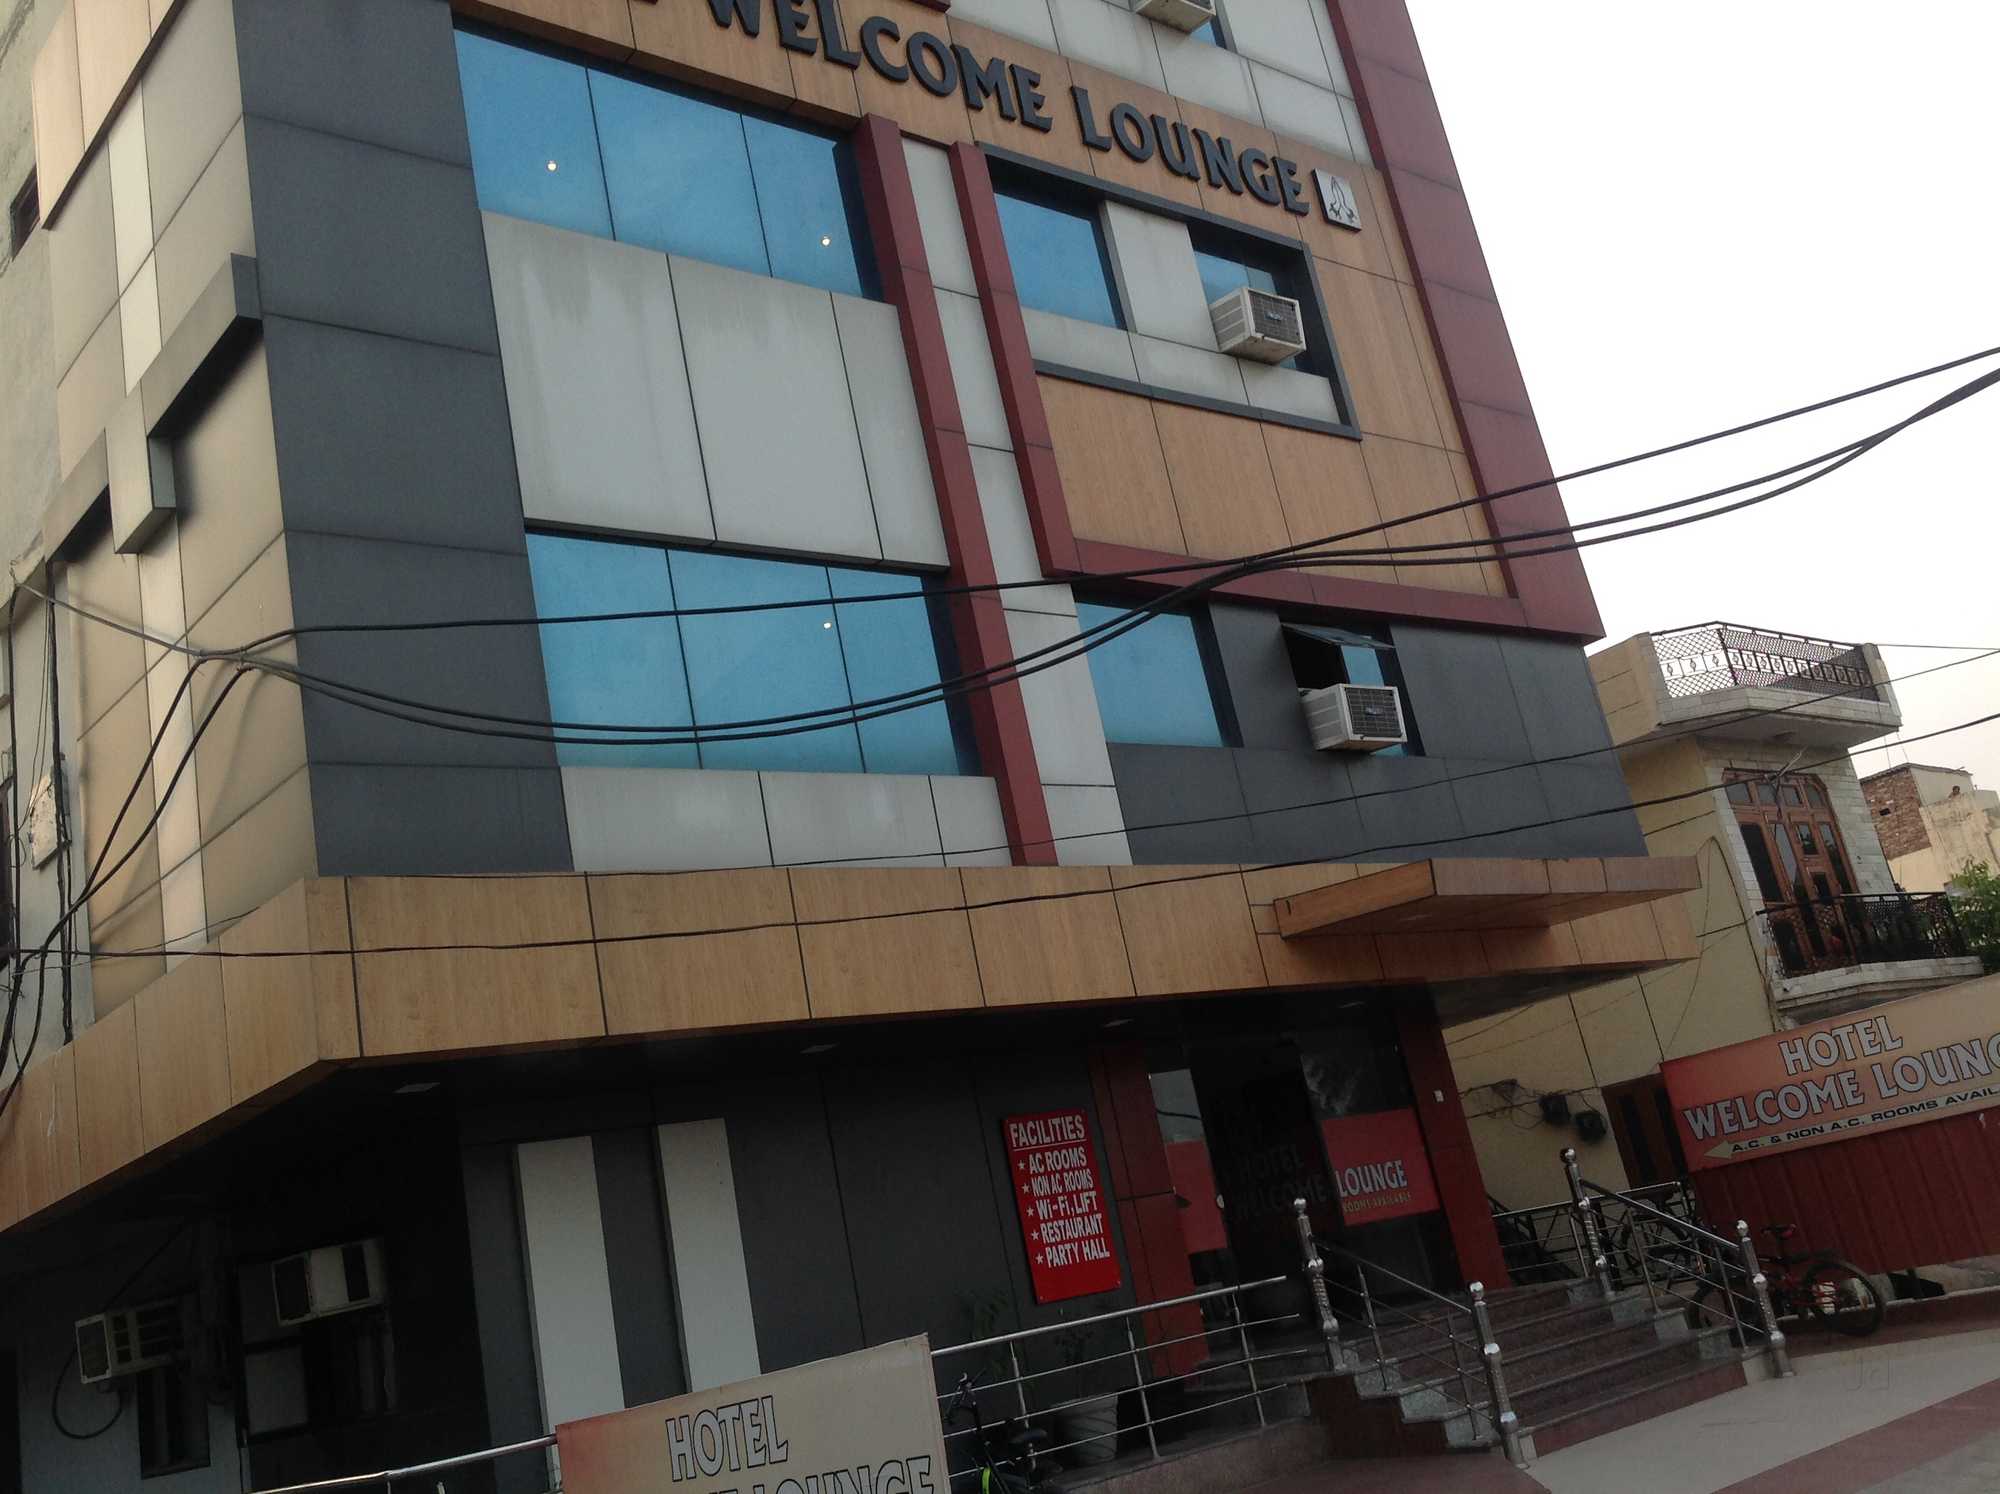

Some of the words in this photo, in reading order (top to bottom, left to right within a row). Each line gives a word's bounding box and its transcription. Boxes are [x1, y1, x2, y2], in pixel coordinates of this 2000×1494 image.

[1069, 86, 1311, 214] LOUNGE
[1778, 1015, 1903, 1076] HOTEL
[1683, 1070, 1865, 1141] WELCOME
[1009, 1115, 1085, 1148] FACILITIES
[1732, 1137, 1763, 1152] A.C.
[1770, 1133, 1783, 1145] &
[1786, 1125, 1825, 1141] NON
[1830, 1117, 1864, 1132] A.C.
[1871, 1101, 1939, 1122] ROOMS
[1029, 1152, 1045, 1174] AC
[1046, 1147, 1088, 1172] ROOMS
[1335, 1160, 1408, 1198] LOUNGE
[1031, 1174, 1052, 1197] NON
[1051, 1173, 1063, 1194] AC
[1064, 1168, 1094, 1191] ROOMS
[1040, 1214, 1104, 1244] RESTAURANT
[1045, 1242, 1081, 1268] PARTY
[1082, 1237, 1110, 1262] HALL
[665, 1395, 789, 1482] HOTEL
